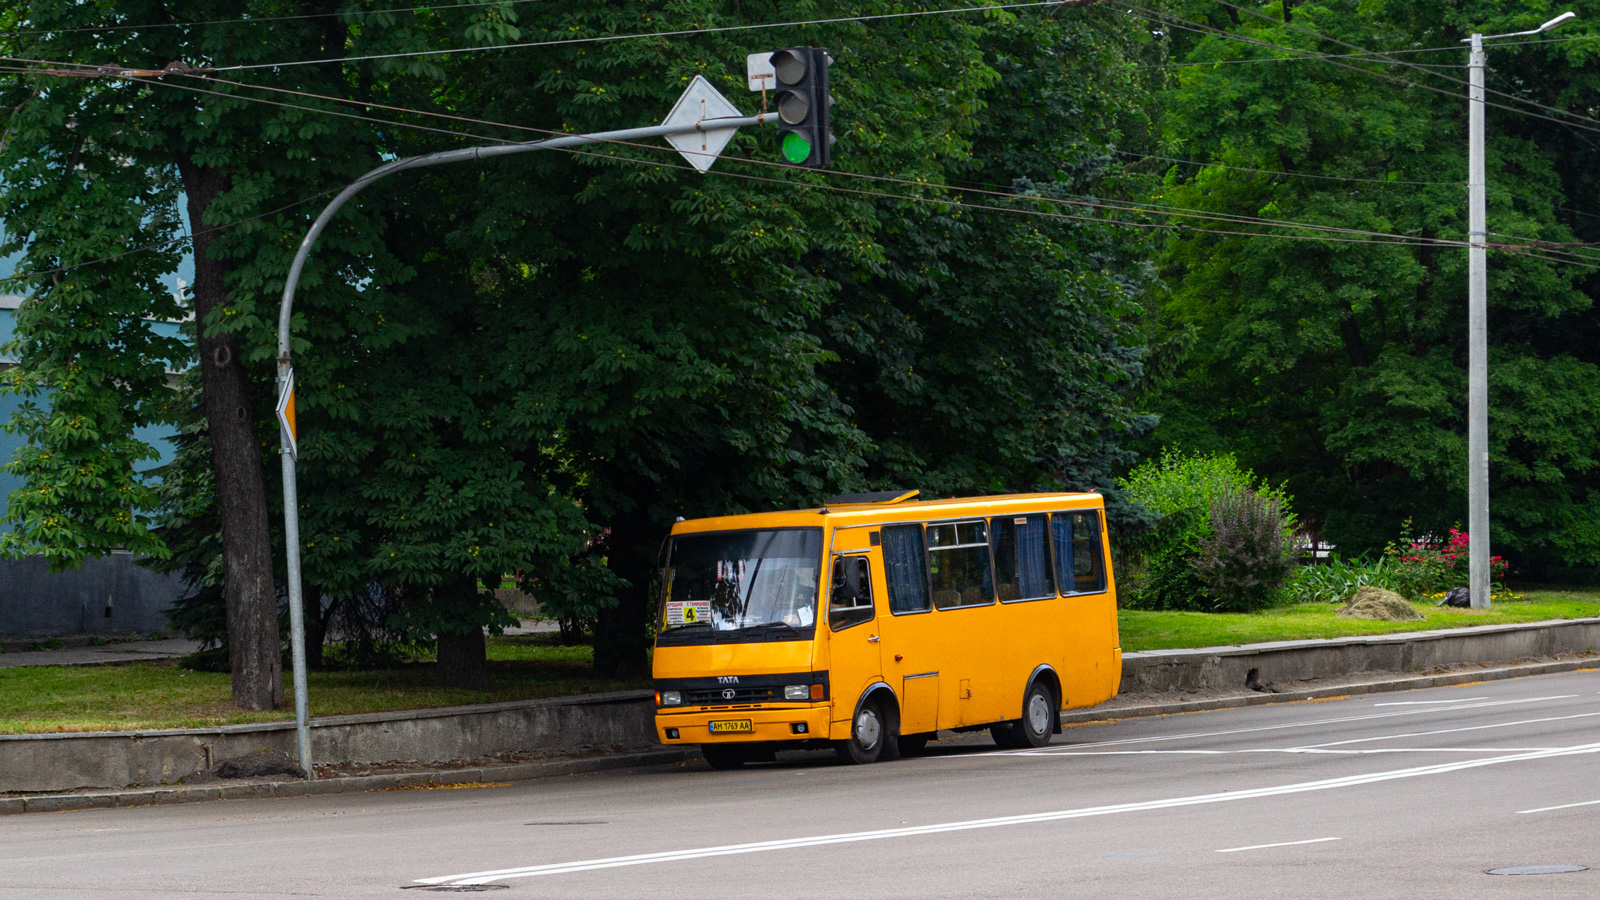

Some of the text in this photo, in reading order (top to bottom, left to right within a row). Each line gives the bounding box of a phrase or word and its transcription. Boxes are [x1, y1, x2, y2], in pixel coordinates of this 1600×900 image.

[686, 608, 694, 621] 4
[717, 676, 739, 684] TATA
[713, 722, 749, 730] AM 1769 AA
